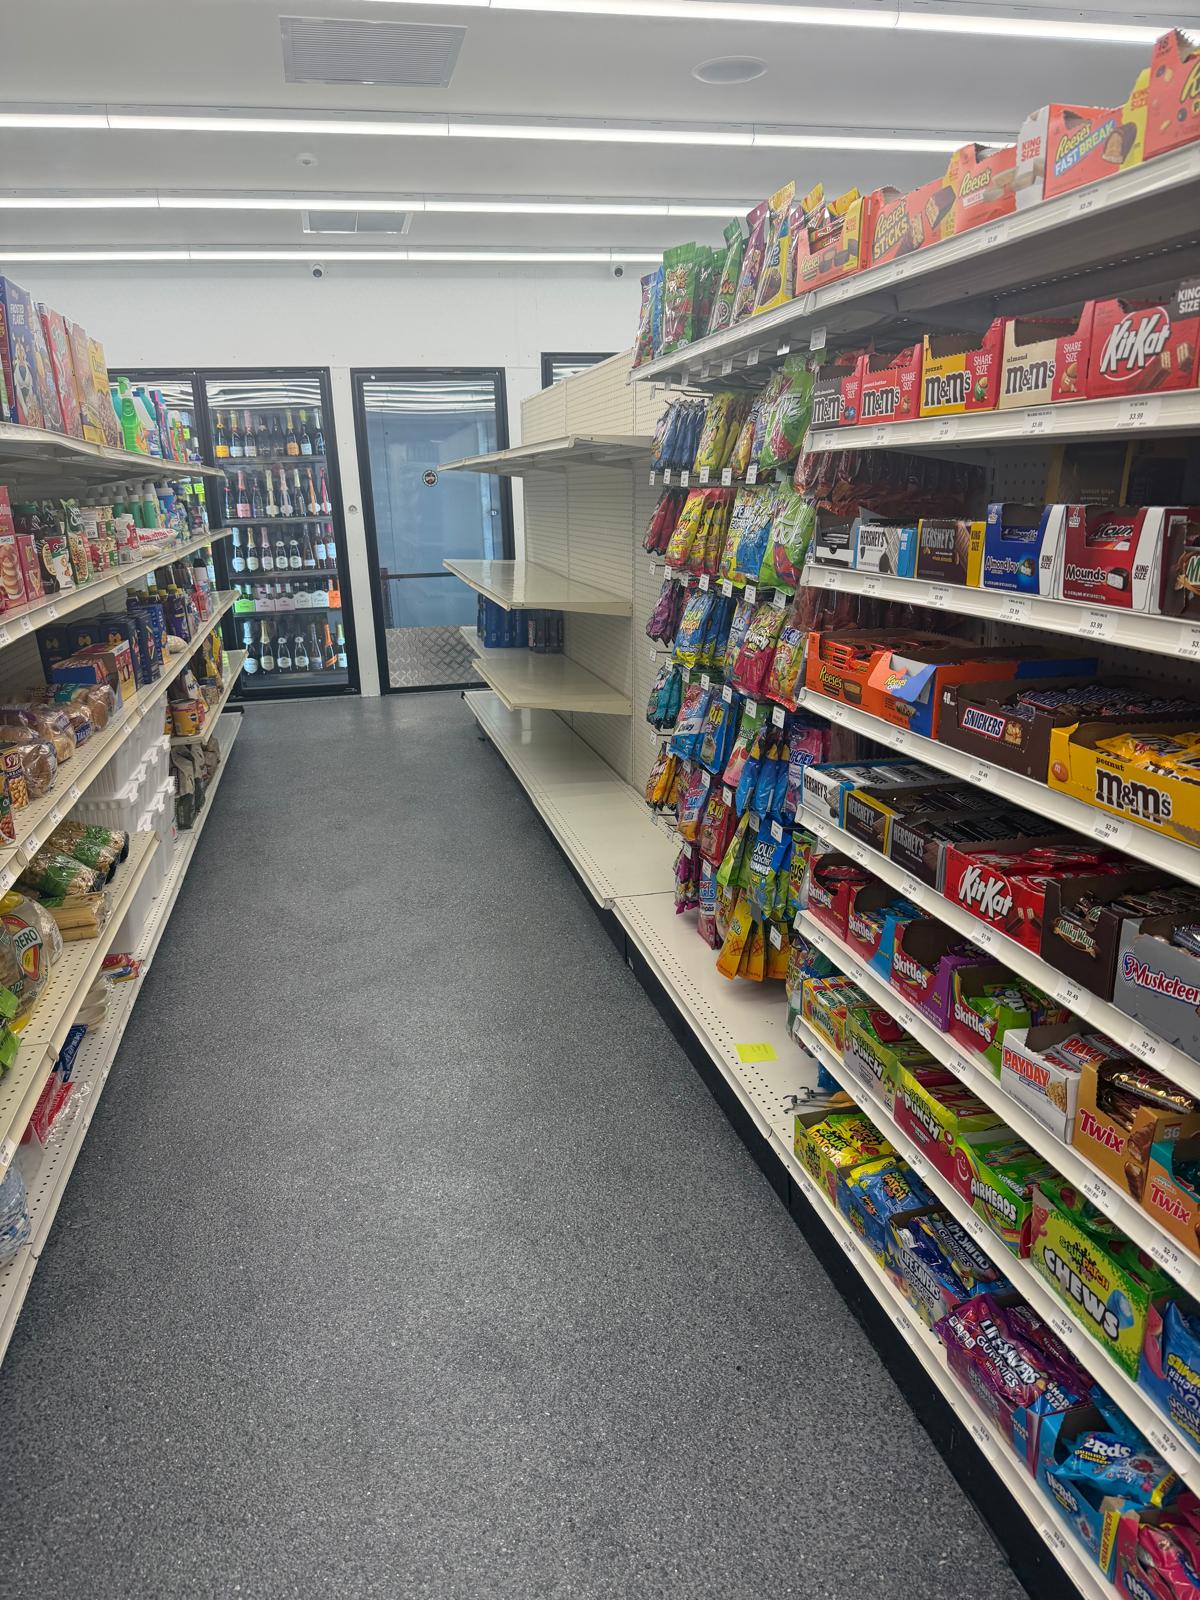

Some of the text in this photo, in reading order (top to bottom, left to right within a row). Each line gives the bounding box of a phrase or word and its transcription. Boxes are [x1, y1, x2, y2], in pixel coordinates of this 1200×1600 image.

[1020, 148, 1041, 162] SIZE
[1021, 136, 1041, 151] KING
[1055, 121, 1115, 176] FAST BREAK
[873, 222, 910, 260] STICKS
[1178, 300, 1200, 314] SIZE
[973, 353, 992, 366] SHARE
[1007, 353, 1028, 363] almond
[1063, 341, 1082, 353] SHARE
[1065, 352, 1078, 363] SIZE
[900, 372, 916, 383] SHARE
[925, 364, 943, 375] peanut
[975, 364, 988, 375] SIZE
[902, 381, 913, 390] SIZE
[921, 528, 956, 549] HERSHEY'S
[1042, 555, 1053, 563] KING
[1135, 565, 1149, 573] KING
[1065, 564, 1106, 581] Mounds
[1133, 572, 1147, 580] SIZE
[963, 708, 1004, 737] SNICKERS
[1095, 755, 1125, 773] peanut
[848, 797, 875, 825] HERSHEY'S
[893, 824, 925, 857] HERSHEY'S
[1105, 824, 1119, 834] $2.99
[809, 883, 832, 909] Skittles
[848, 914, 875, 945] Skittles
[893, 952, 928, 989] Skittles
[1134, 963, 1200, 1006] Musketeer
[954, 1004, 992, 1043] Skittles
[852, 1038, 884, 1080] PUNCH
[1003, 1049, 1050, 1087] PAYDAY
[904, 1095, 941, 1142] PUNCH
[1079, 1108, 1125, 1154] Twix
[812, 1131, 838, 1159] PATCH
[819, 1128, 847, 1152] SOUR
[1164, 1127, 1181, 1139] 36
[882, 1173, 907, 1200] PATCH
[970, 1178, 1018, 1221] AIRHEADS
[1150, 1183, 1191, 1225] Twix
[1043, 1246, 1119, 1342] CHEWS
[976, 1336, 1019, 1388] GUMMIES
[1047, 1382, 1073, 1409] SHAR
